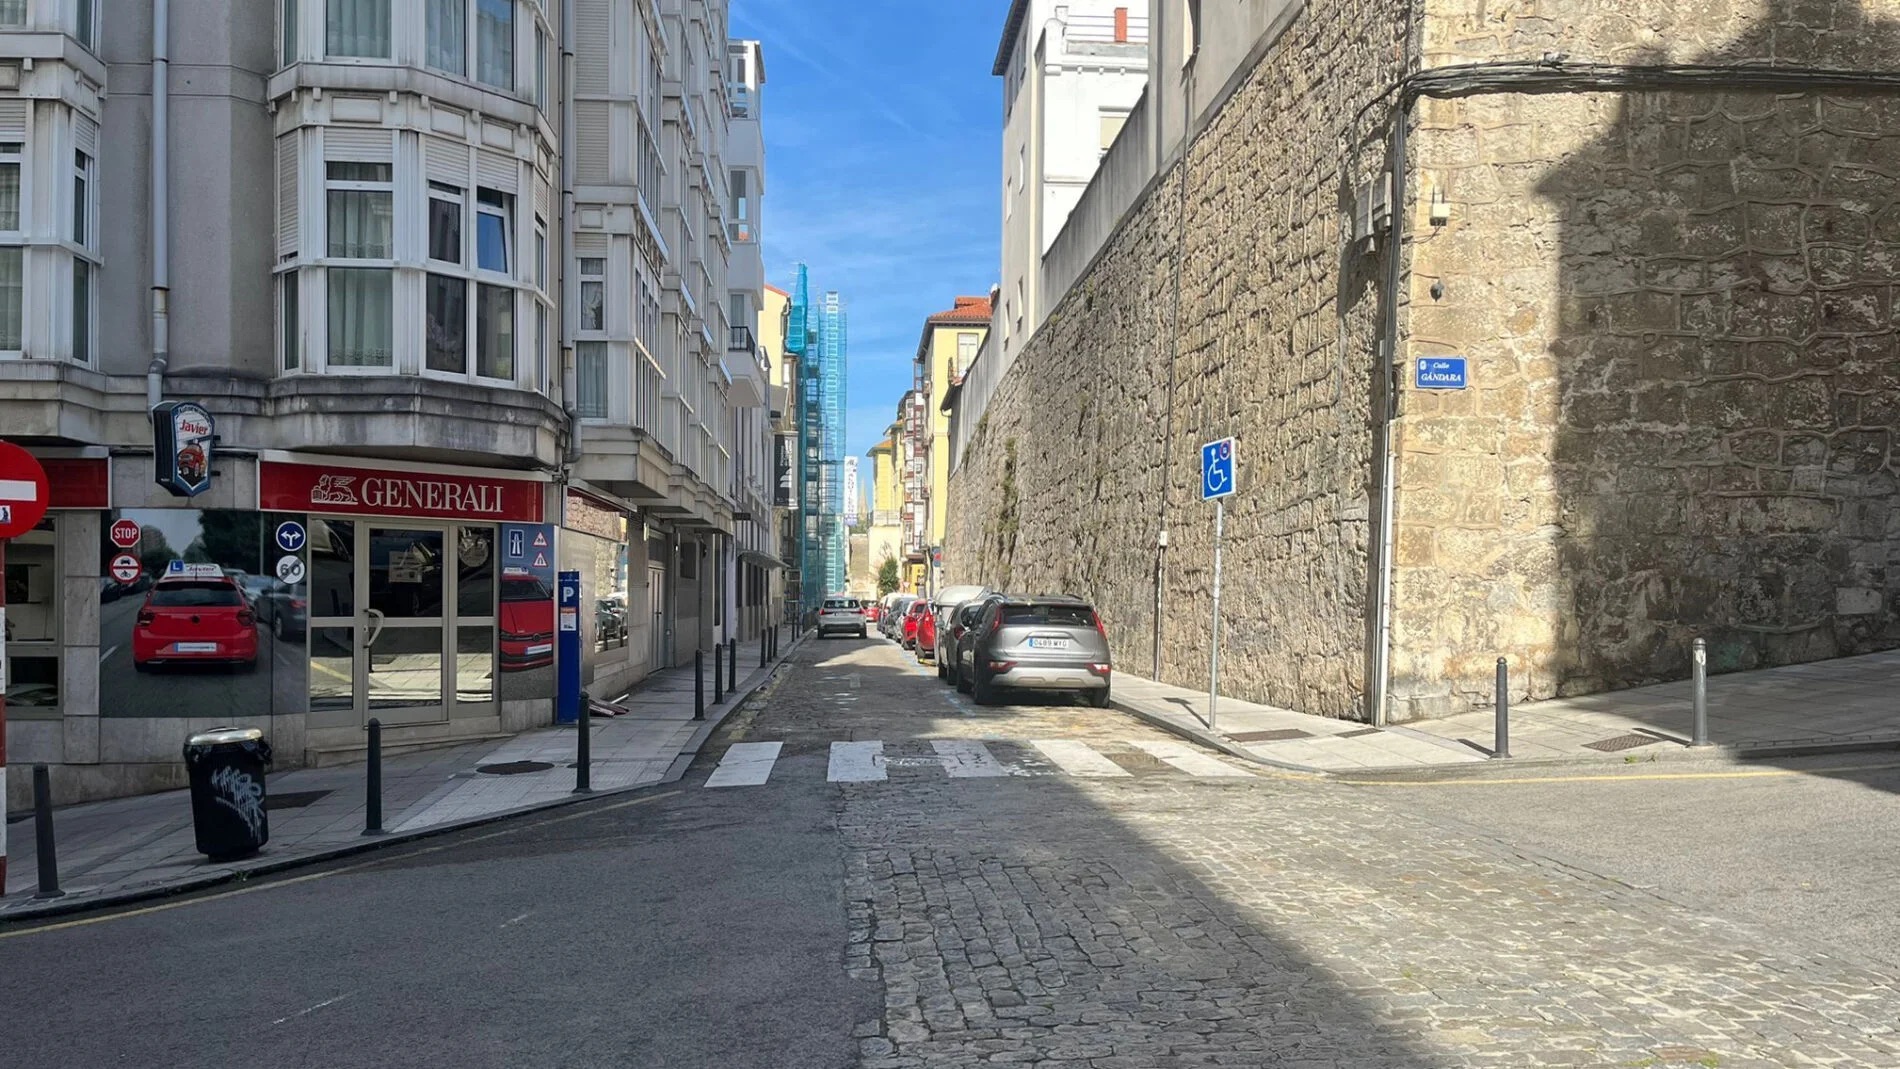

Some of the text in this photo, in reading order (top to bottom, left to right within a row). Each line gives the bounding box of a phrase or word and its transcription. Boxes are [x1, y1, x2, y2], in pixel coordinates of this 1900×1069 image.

[1421, 372, 1462, 382] GÁNDARA
[179, 419, 209, 435] Javier
[361, 476, 504, 513] GENERALI
[114, 528, 138, 539] STOP
[172, 562, 180, 570] L
[280, 563, 301, 576] 60
[563, 586, 574, 603] P
